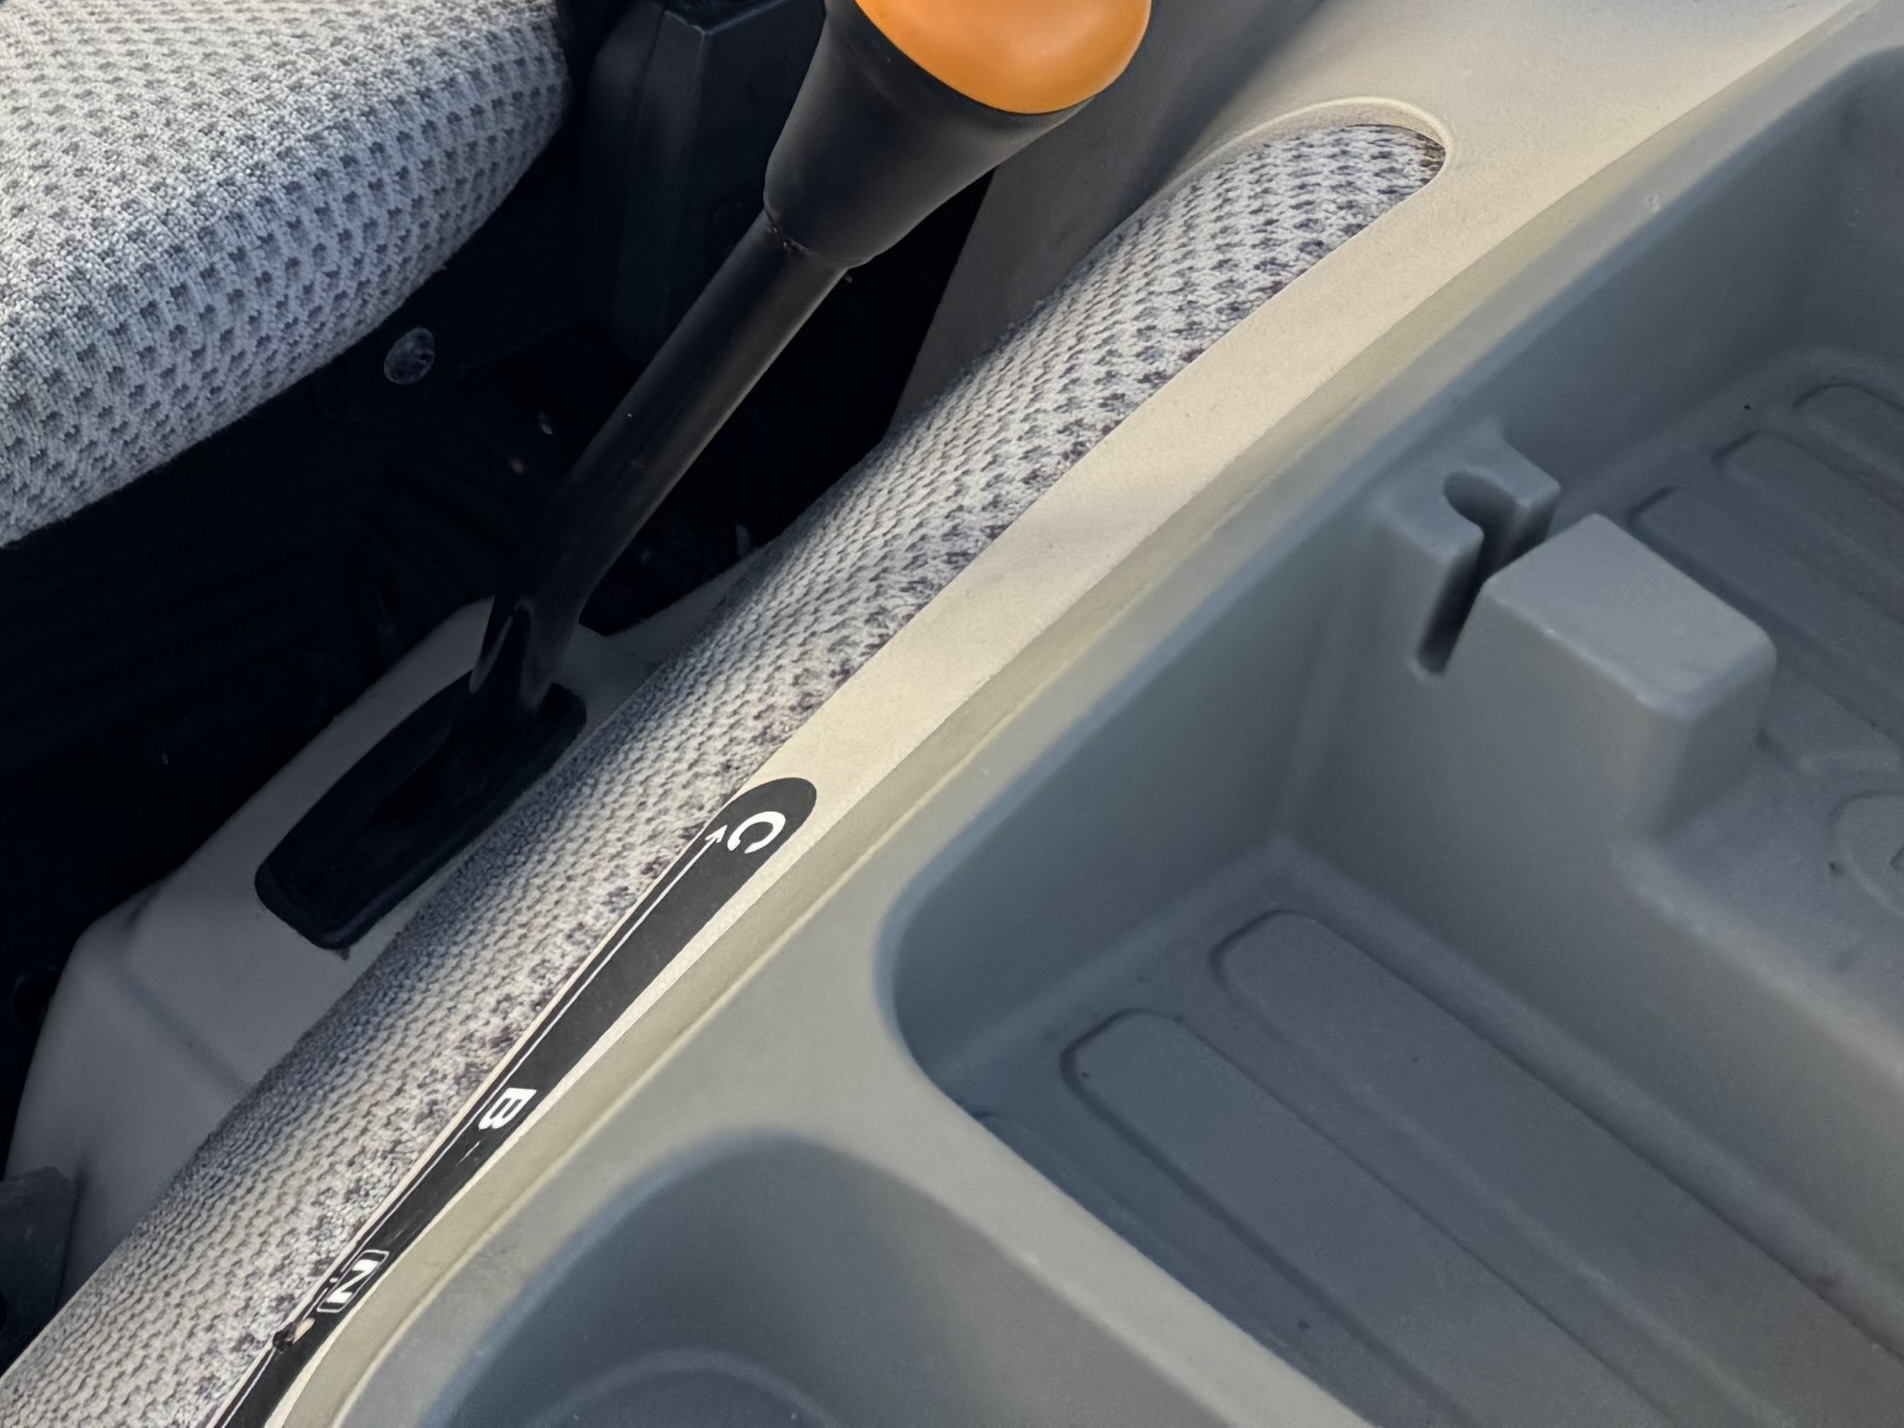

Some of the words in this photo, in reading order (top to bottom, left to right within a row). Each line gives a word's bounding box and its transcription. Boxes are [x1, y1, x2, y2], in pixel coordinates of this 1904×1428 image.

[727, 810, 786, 854] C
[478, 1087, 537, 1131] B
[326, 1259, 380, 1303] N
